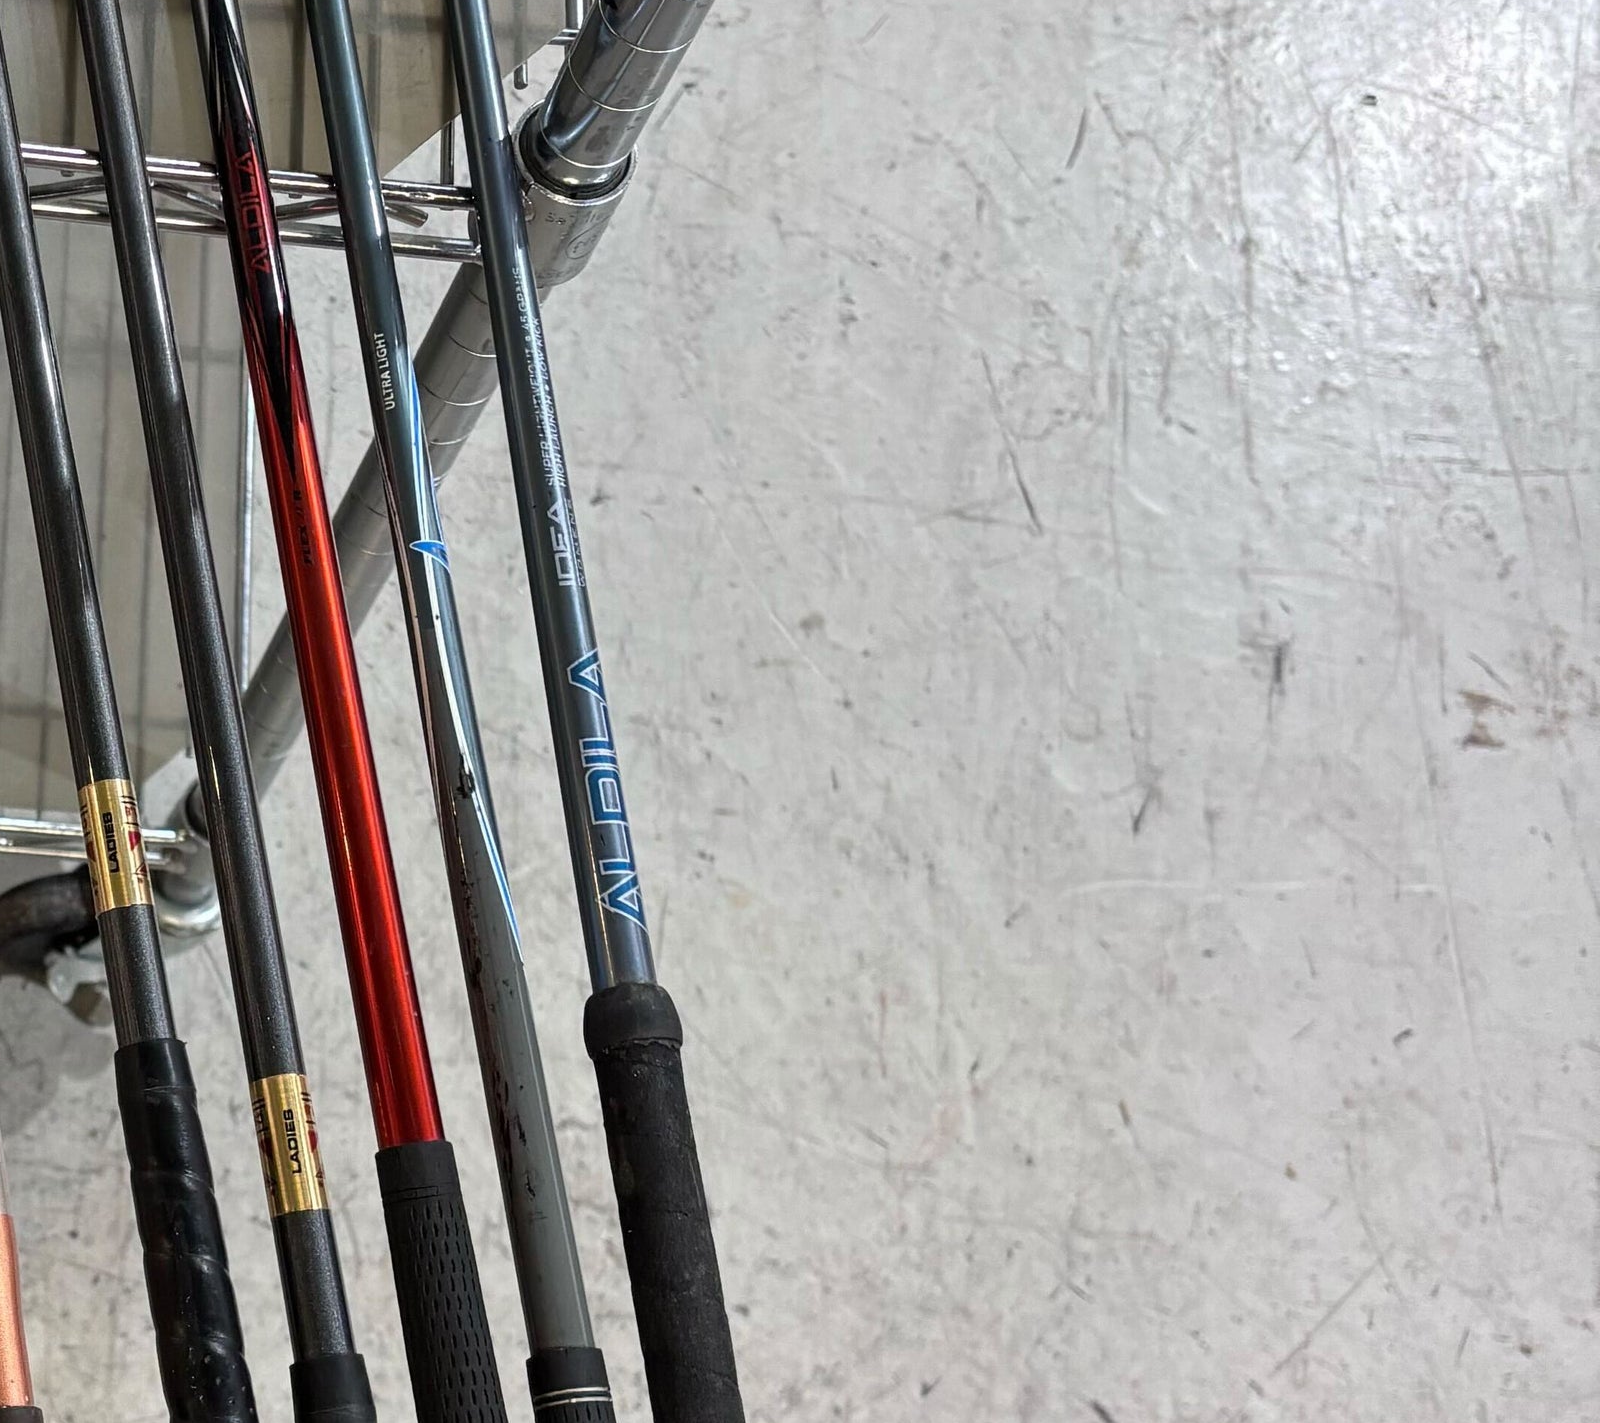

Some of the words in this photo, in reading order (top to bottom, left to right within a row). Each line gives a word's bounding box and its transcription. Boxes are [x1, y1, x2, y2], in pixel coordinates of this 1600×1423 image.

[234, 151, 270, 273] ALDILA
[373, 332, 389, 369] LIGHT
[379, 370, 396, 410] ULTRA
[547, 498, 575, 587] IDEA
[566, 647, 649, 934] ALDILA
[102, 811, 120, 873] LADIES
[282, 1108, 302, 1174] LADIES
